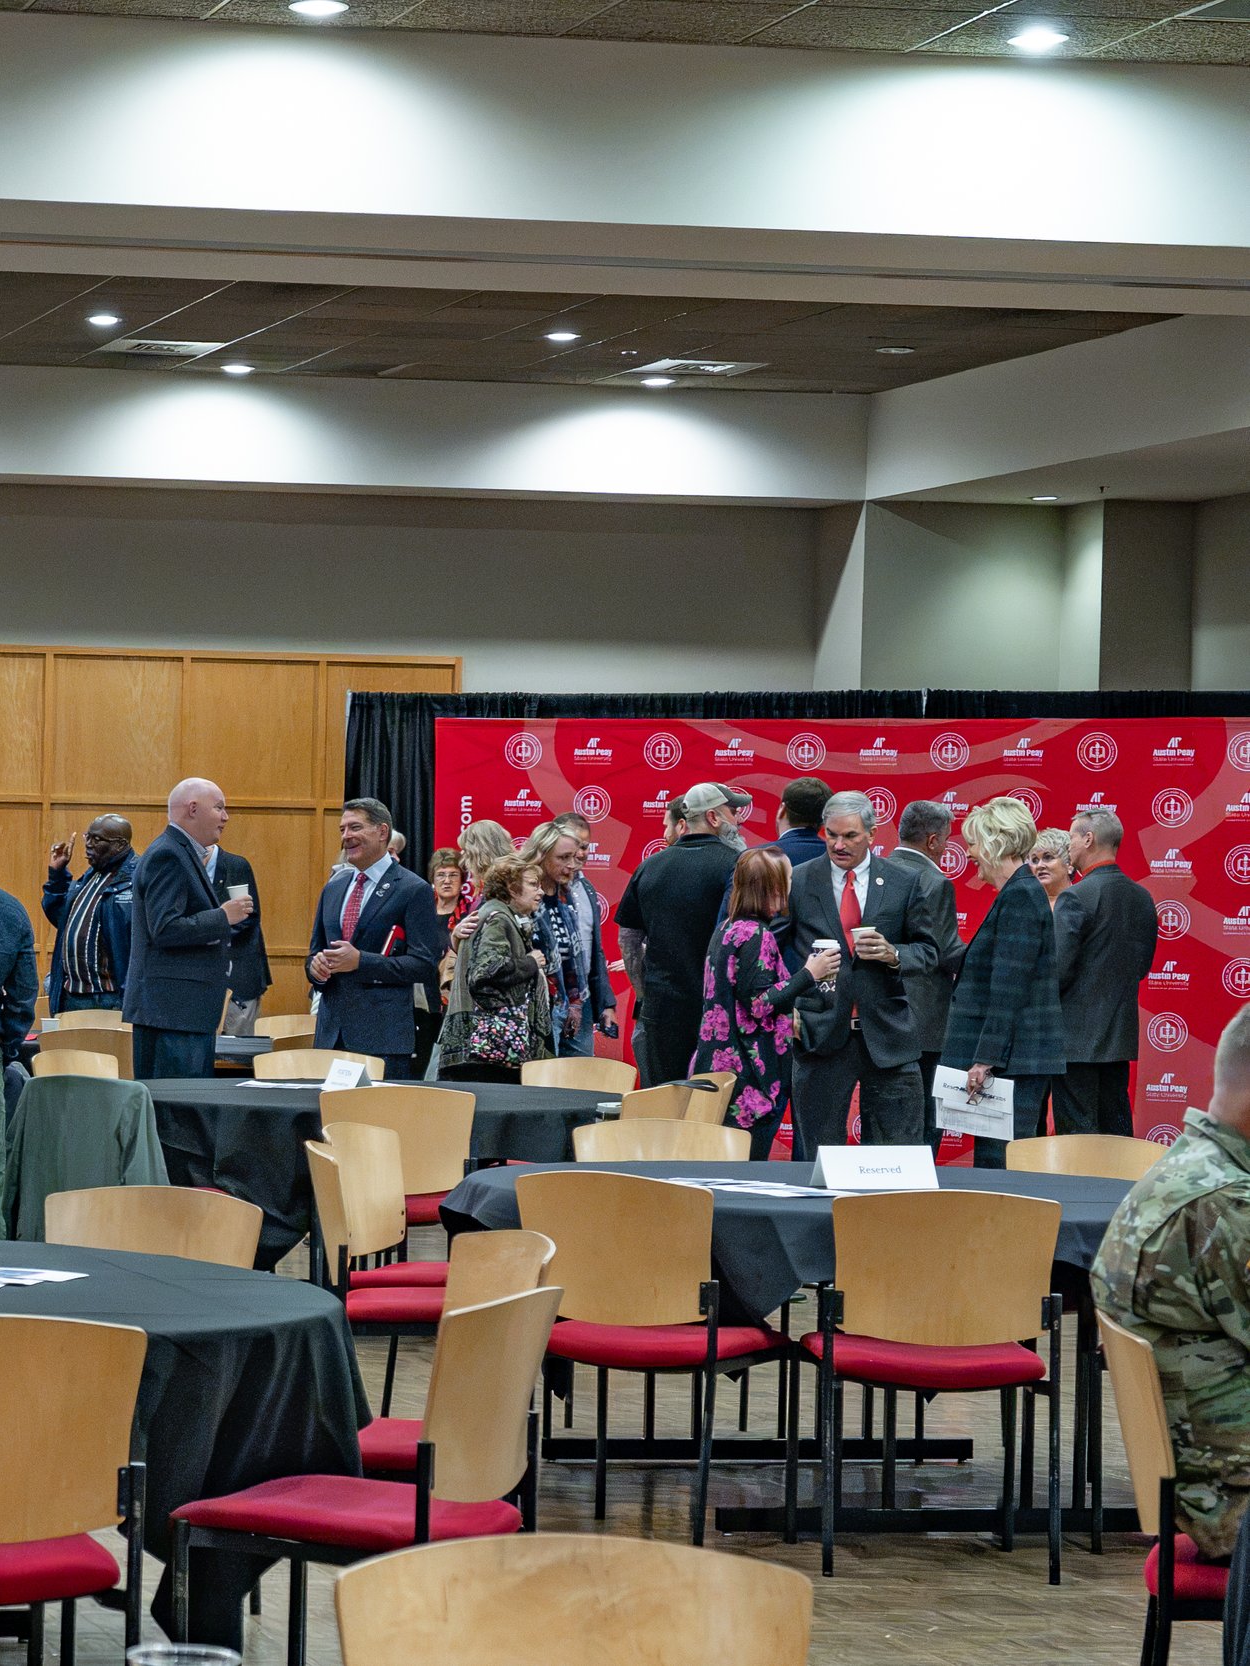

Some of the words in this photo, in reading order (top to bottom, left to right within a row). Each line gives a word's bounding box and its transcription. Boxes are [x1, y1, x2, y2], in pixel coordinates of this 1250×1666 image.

[574, 748, 594, 756] Austin
[595, 748, 613, 757] Peay
[714, 749, 736, 757] Austin
[737, 749, 754, 758] Peay
[860, 748, 880, 756] Austin
[881, 748, 898, 757] Peay
[1003, 749, 1025, 757] Austin
[1026, 749, 1044, 758] Peay
[1153, 749, 1176, 757] Austin
[1177, 749, 1195, 758] Peay
[525, 800, 542, 808] Peay
[952, 803, 969, 812] Peay
[1226, 804, 1249, 812] Austin
[1150, 860, 1174, 868] Austin
[1174, 860, 1192, 869] Peay
[1223, 917, 1247, 925] Austin
[1148, 972, 1171, 980] Austin
[1172, 972, 1190, 982] Peay
[1146, 1084, 1169, 1092] Austin
[1170, 1084, 1188, 1094] Peay
[858, 1165, 902, 1174] Reserved
